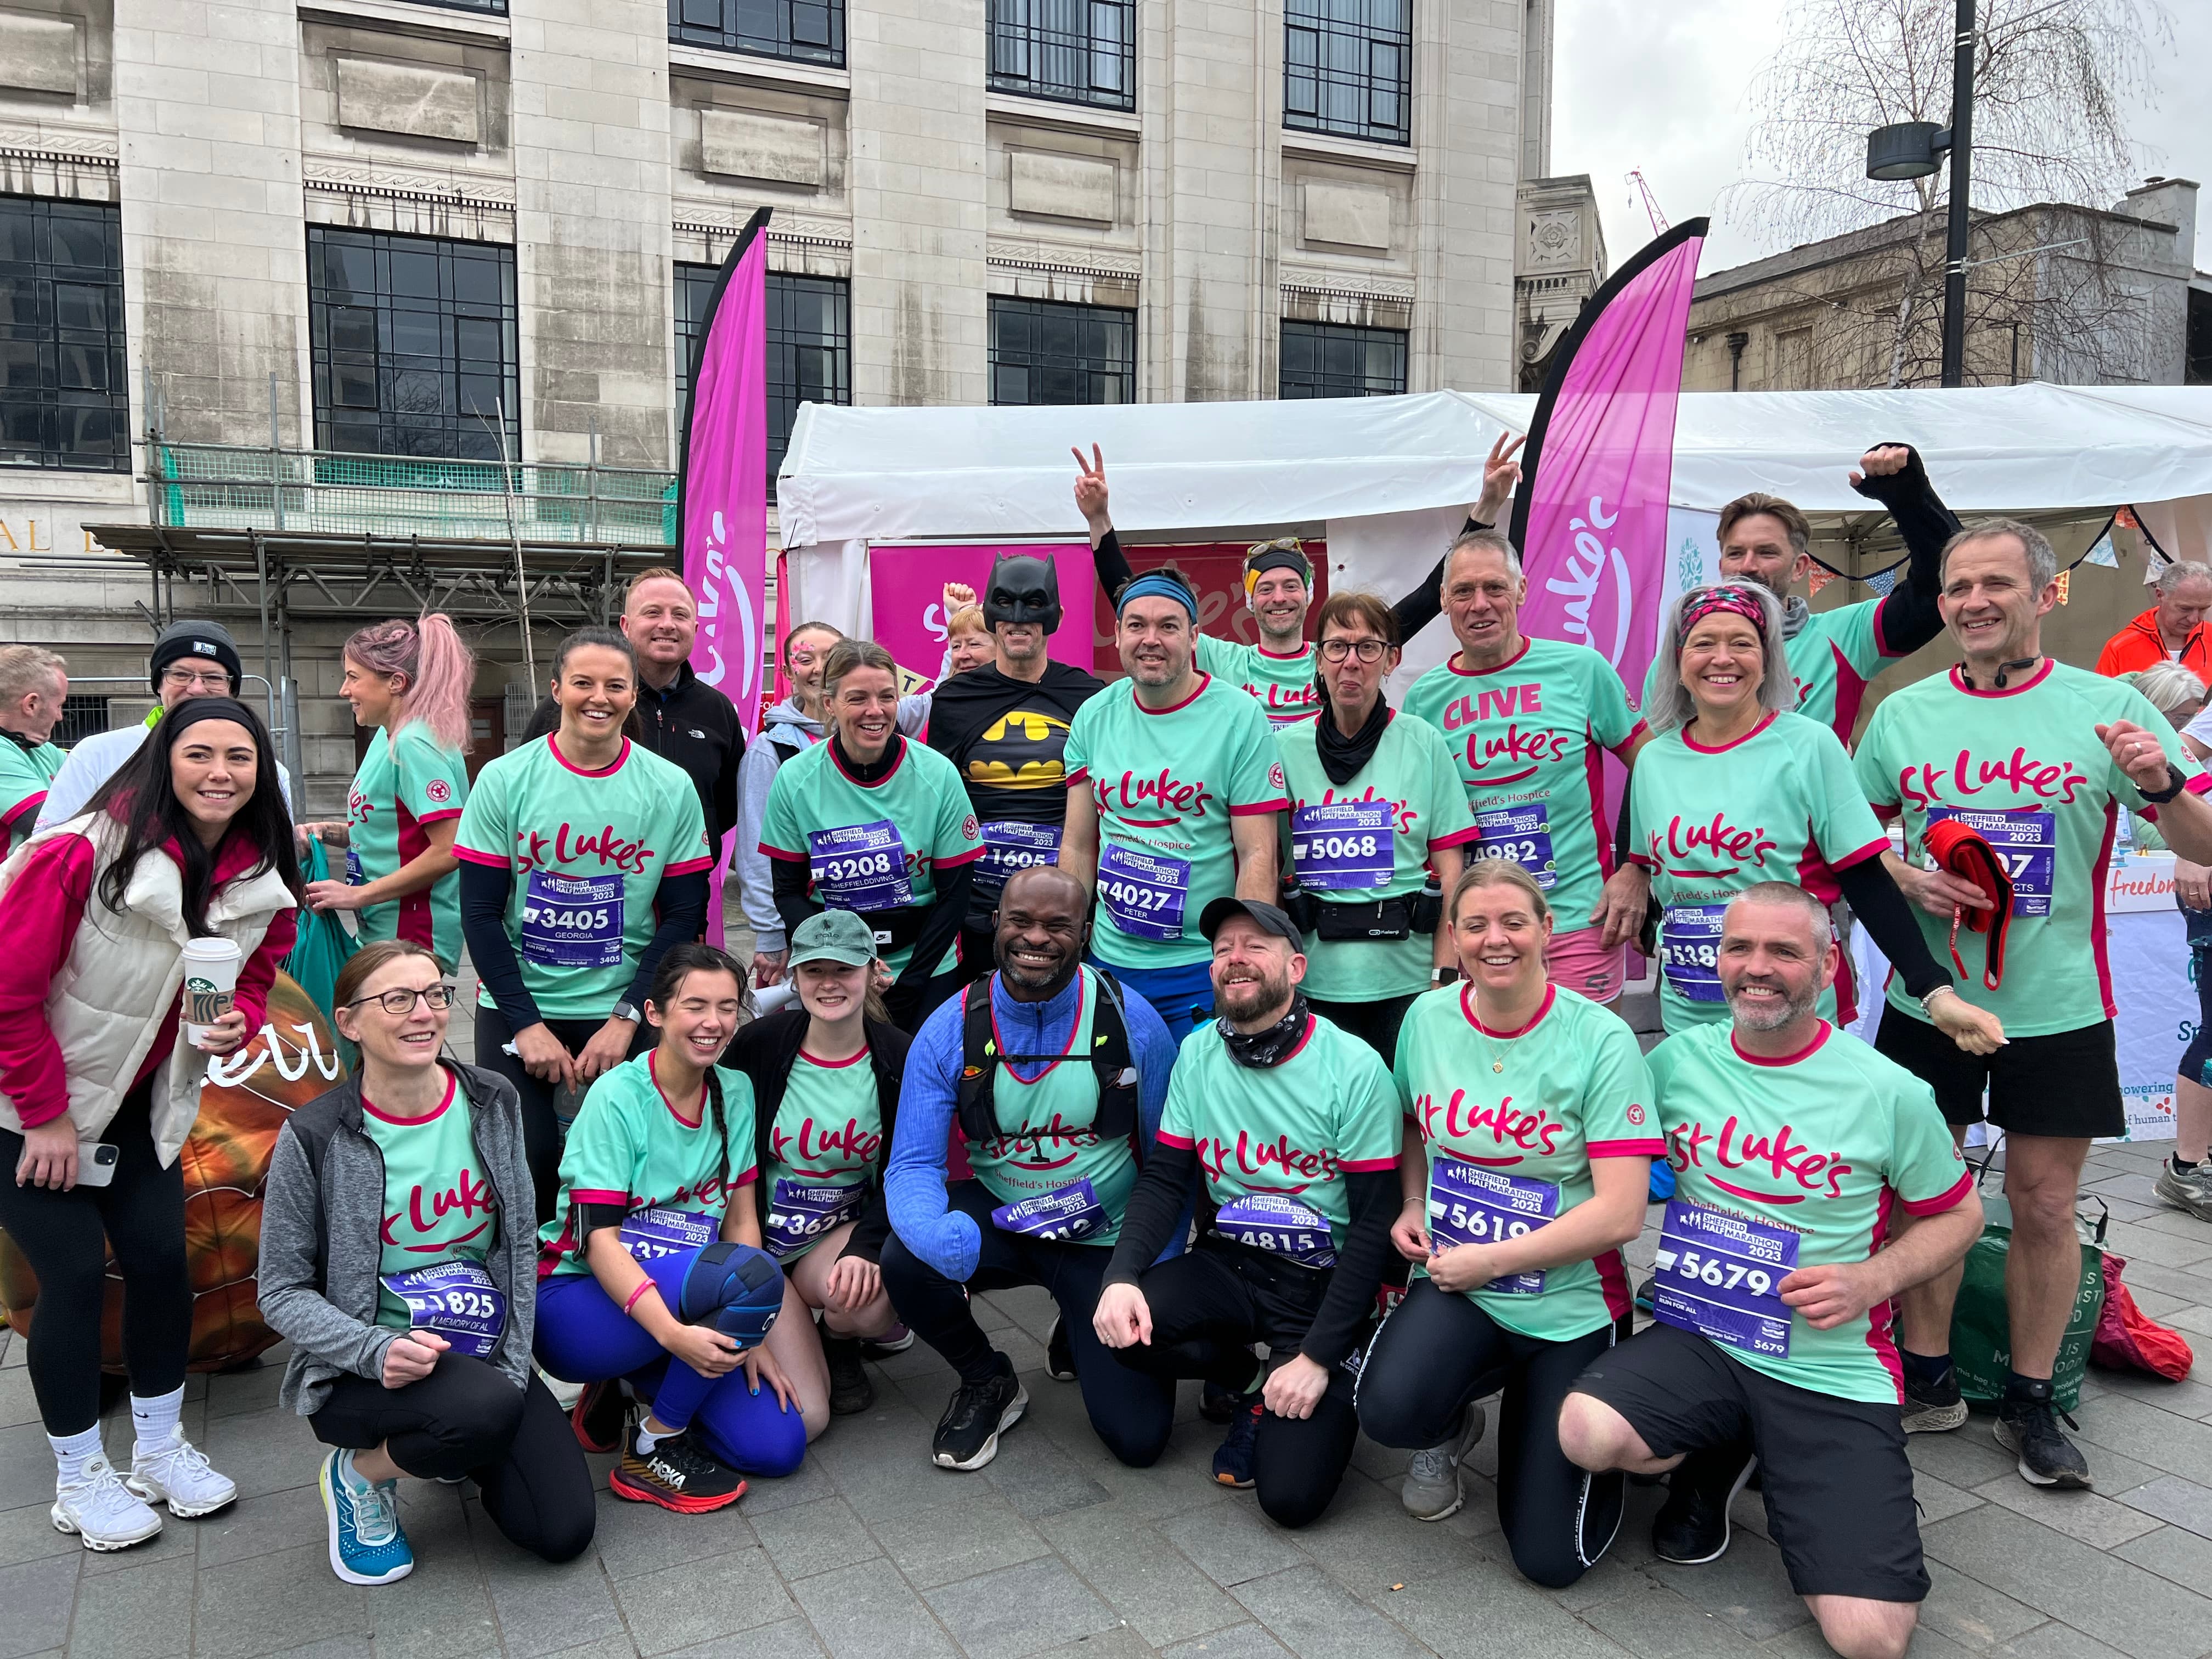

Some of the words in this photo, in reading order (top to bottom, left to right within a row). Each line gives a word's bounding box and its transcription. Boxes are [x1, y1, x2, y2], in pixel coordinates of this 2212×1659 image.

[904, 675, 917, 692] T
[1443, 683, 1542, 730] CLIVE
[1467, 724, 1568, 770] Luke's
[1955, 747, 2087, 804] Luke's
[1120, 768, 1213, 817] Luke's
[1508, 790, 1551, 803] Hospice
[1339, 811, 1381, 819] MARATHON
[1476, 812, 1508, 822] SHEFFIELD
[1494, 815, 1537, 825] MARATHON
[1961, 813, 2005, 823] SHEFFIELD
[832, 827, 863, 838] SHEFFIELD
[1514, 822, 1538, 832] 2023
[1984, 823, 2041, 832] MARATHON
[850, 829, 889, 842] MARATHON
[1019, 830, 1053, 839] MARATHON
[1668, 812, 1777, 867] Luke's
[2010, 832, 2041, 842] 2023
[555, 822, 654, 874] Luke's
[868, 837, 891, 847] 2023
[1034, 838, 1053, 846] 2023
[1148, 838, 1190, 851] Hospice
[1312, 836, 1376, 860] 5068
[993, 848, 1045, 868] 1605
[1124, 853, 1154, 865] SHEFFIELD
[828, 853, 890, 881] 3208
[1123, 859, 1138, 869] HALF
[1138, 863, 1179, 876] MARATHON
[1155, 874, 1178, 884] 2023
[573, 884, 614, 894] MARATHON
[592, 891, 614, 901] 2023
[1109, 881, 1171, 911] 4027
[893, 894, 912, 904] 3208
[540, 908, 608, 930] 3405
[1125, 908, 1148, 919] PETER
[1709, 924, 1723, 933] 20
[600, 955, 620, 964] 3405
[1447, 1088, 1562, 1155] Luke's
[2133, 1114, 2168, 1124] human
[1237, 1130, 1337, 1181] Luke's
[1717, 1115, 1852, 1199] Luke's
[994, 1168, 1042, 1189] Sheffield's
[1469, 1169, 1510, 1186] SHEFFIELD
[1469, 1177, 1489, 1189] HALF
[1489, 1181, 1543, 1201] MARATHON
[1020, 1195, 1054, 1209] SHEFFIELD
[1024, 1207, 1042, 1216] HALF
[1041, 1192, 1084, 1212] MARATHON
[1062, 1200, 1087, 1215] 2023
[1252, 1196, 1290, 1205] SHEFFIELD
[1511, 1198, 1542, 1213] 2023
[1252, 1204, 1271, 1212] HALF
[650, 1209, 686, 1222] SHEFFIELD
[788, 1209, 849, 1235] 3625
[1291, 1215, 1318, 1226] 2023
[1703, 1212, 1747, 1233] SHEFFIELD
[650, 1217, 667, 1226] HALF
[667, 1221, 710, 1234] MARATHON
[685, 1232, 708, 1243] 2023
[1240, 1231, 1315, 1252] 4815
[1702, 1222, 1725, 1235] HALF
[1724, 1229, 1782, 1251] MARATHON
[1748, 1245, 1782, 1262] 2023
[424, 1262, 462, 1276] SHEFFIELD
[1679, 1251, 1771, 1297] 5679
[471, 1276, 492, 1286] 2023
[1658, 1297, 1672, 1307] RUN
[1673, 1301, 1685, 1311] FOR
[1685, 1306, 1697, 1315] ALL
[438, 1317, 469, 1328] MEMORY
[478, 1323, 488, 1331] AL
[1754, 1339, 1785, 1354] 5679
[1956, 1367, 1971, 1378] This
[1973, 1374, 1989, 1386] bag
[1977, 1385, 1998, 1398] We're
[647, 1457, 686, 1489] HOKA
